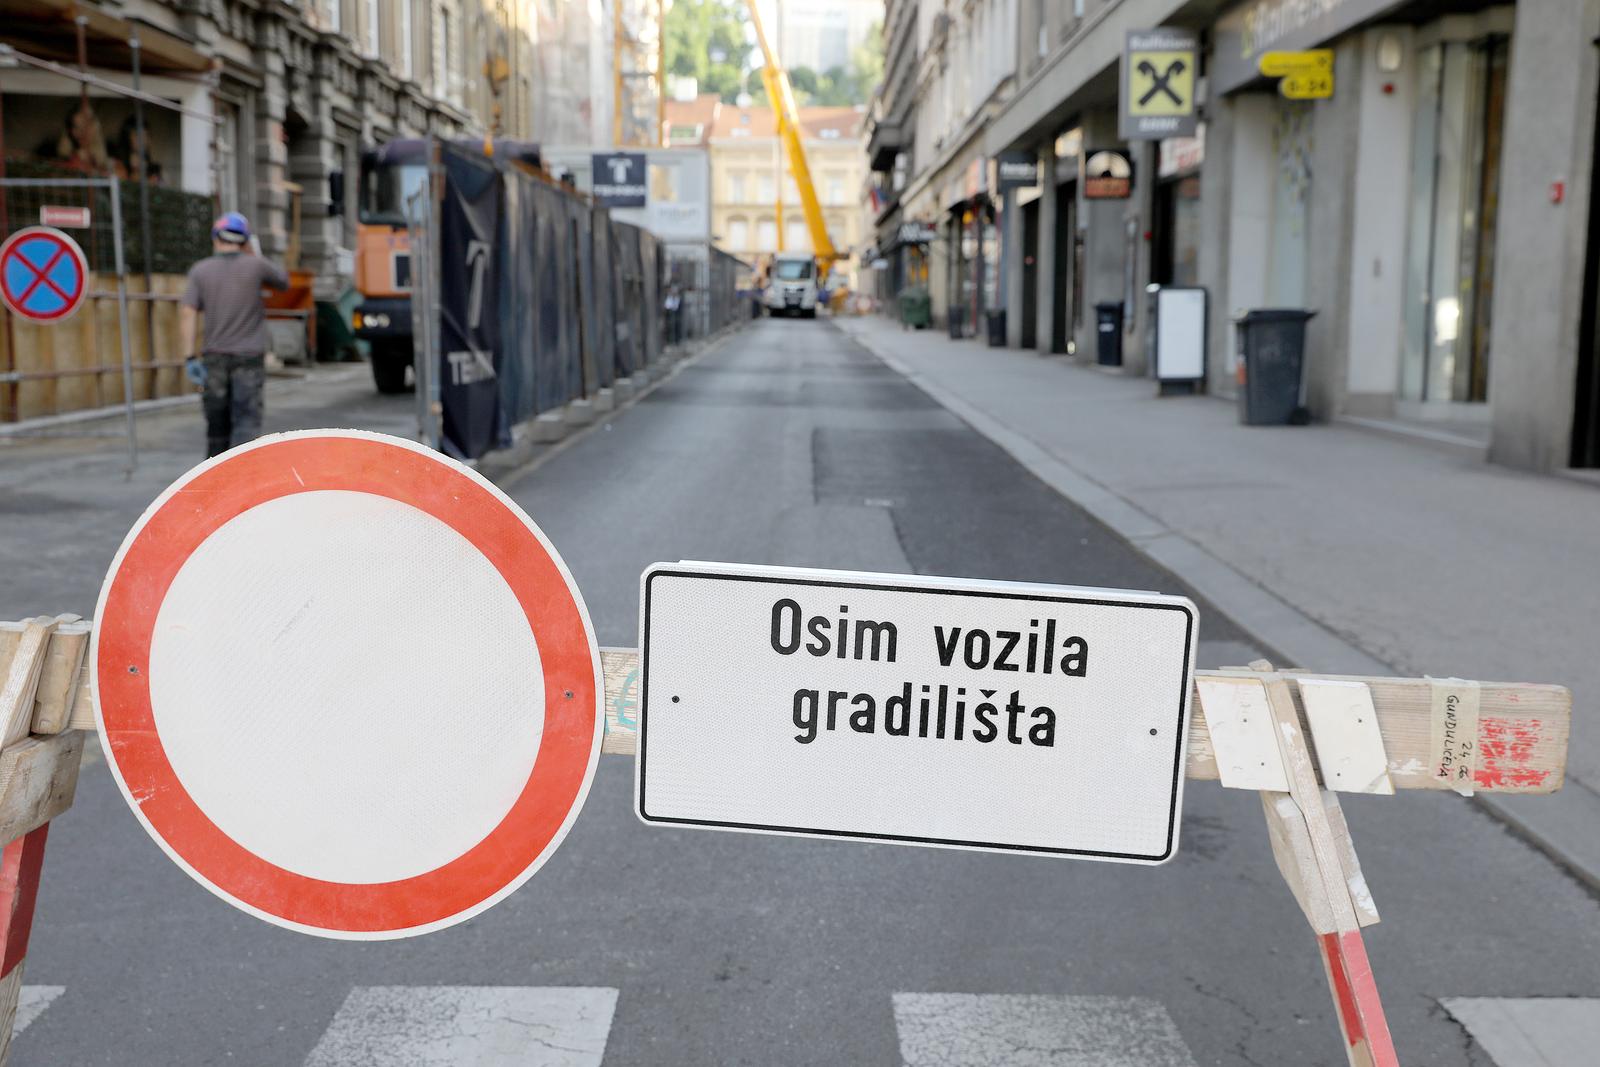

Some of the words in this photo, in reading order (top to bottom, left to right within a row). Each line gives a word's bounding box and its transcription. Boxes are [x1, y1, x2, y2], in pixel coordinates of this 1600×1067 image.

[770, 598, 898, 663] Osim
[934, 618, 1089, 677] vozila
[792, 681, 1057, 747] gradilišta
